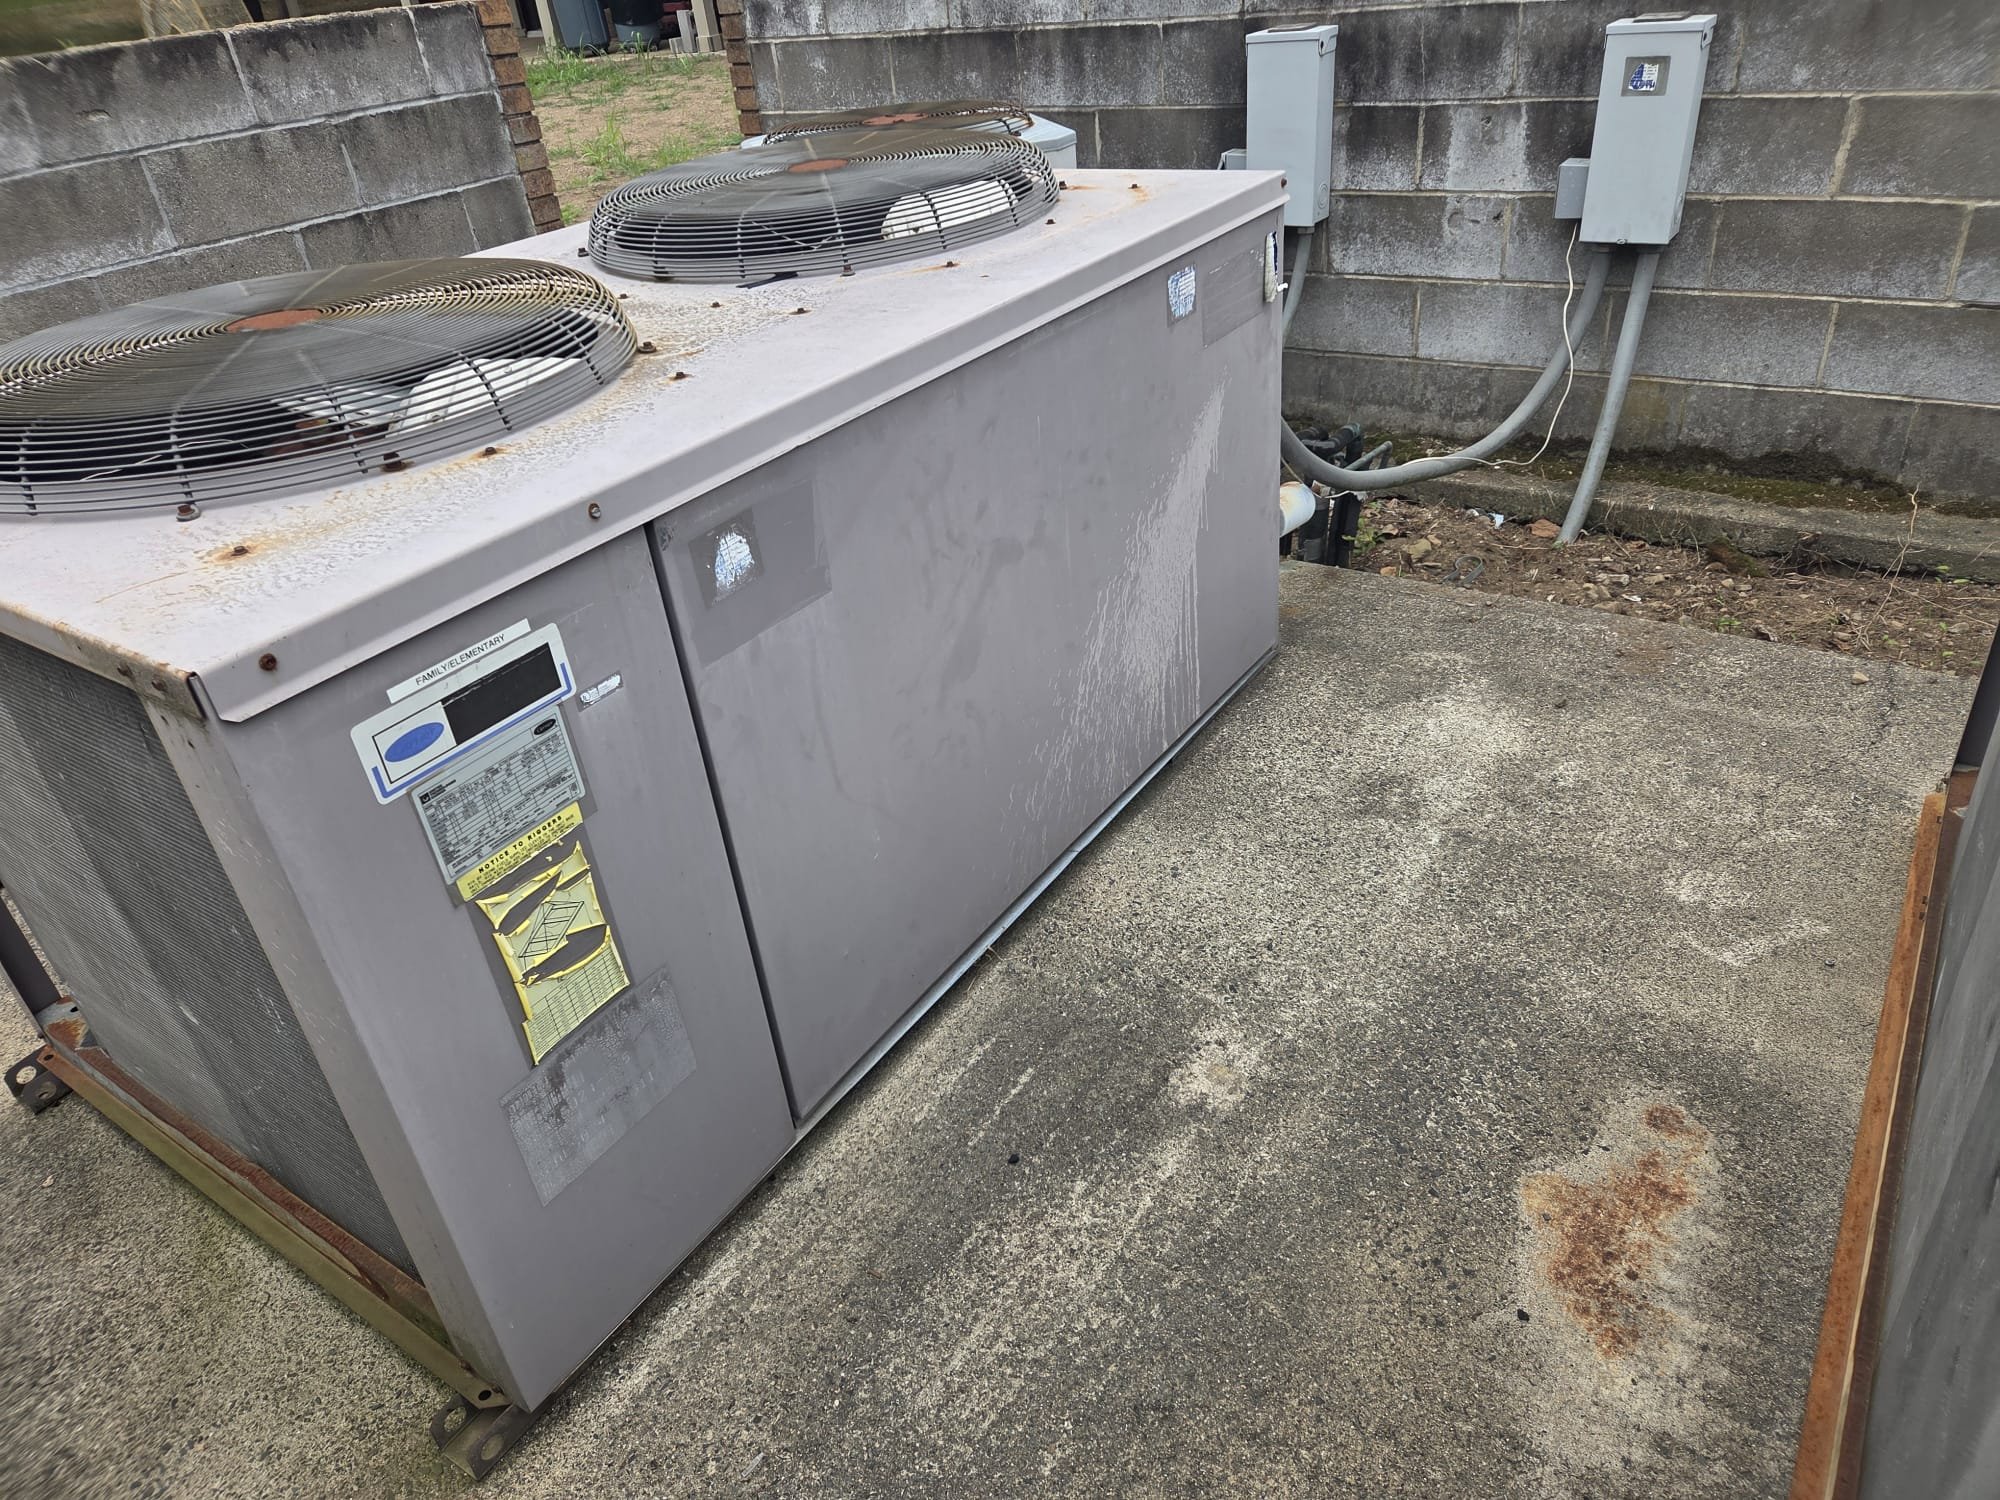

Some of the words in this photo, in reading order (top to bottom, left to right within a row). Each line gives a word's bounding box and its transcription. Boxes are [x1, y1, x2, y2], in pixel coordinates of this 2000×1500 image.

[415, 634, 505, 685] FAMILY/ELEMENTARY
[478, 850, 510, 873] NOTICE
[513, 841, 524, 850] TO
[527, 815, 562, 841] RIGGERS
